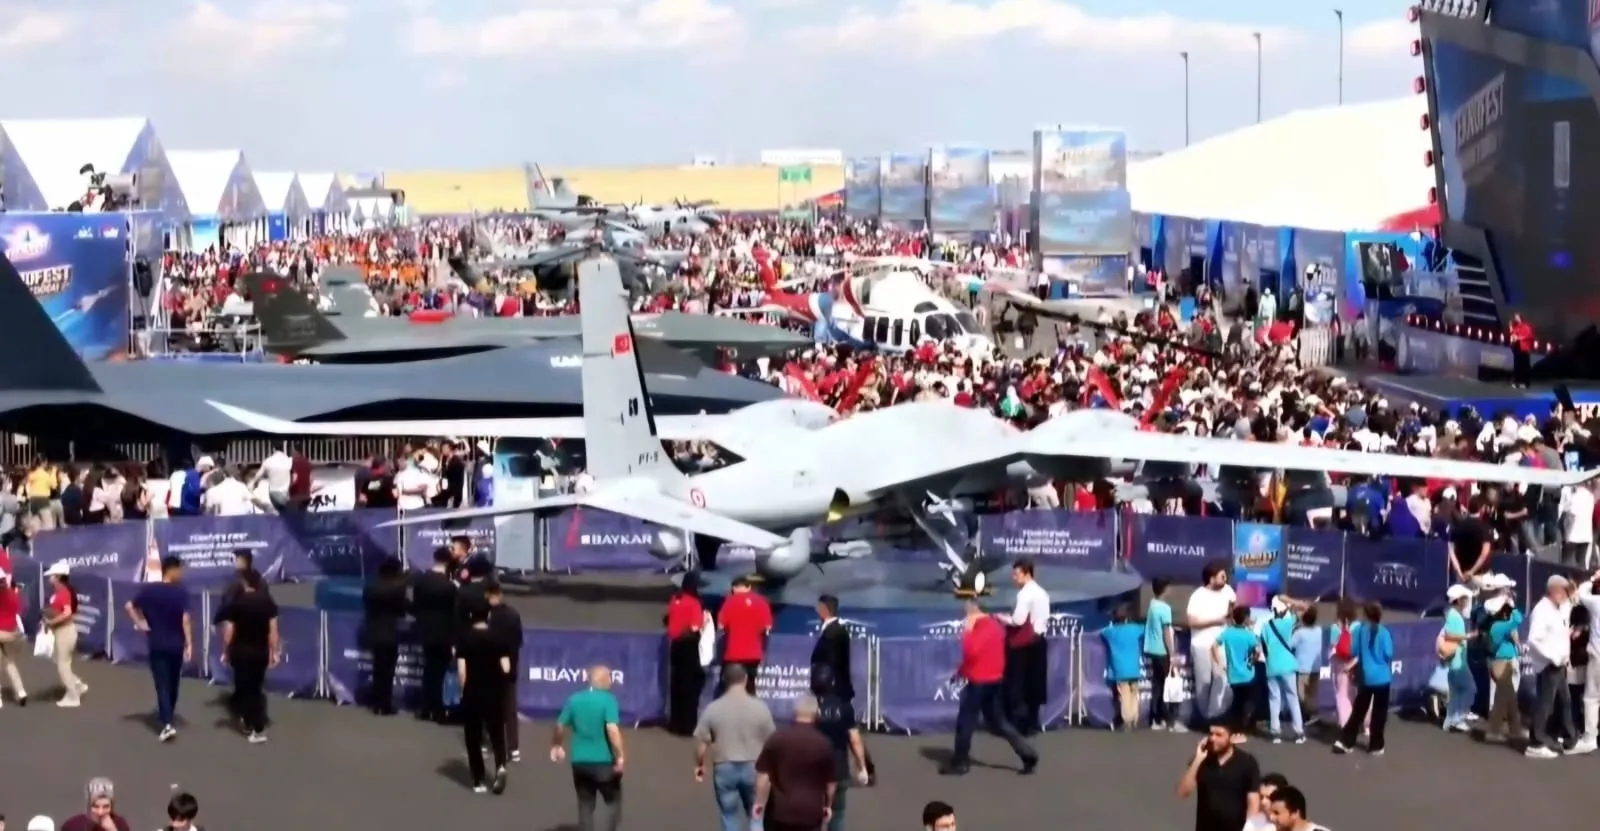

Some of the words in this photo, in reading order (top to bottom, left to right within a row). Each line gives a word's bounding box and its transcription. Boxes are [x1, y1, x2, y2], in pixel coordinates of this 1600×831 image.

[591, 532, 653, 545] BAYKAR
[1155, 543, 1206, 558] BAYKAR
[543, 666, 624, 685] BAYR
